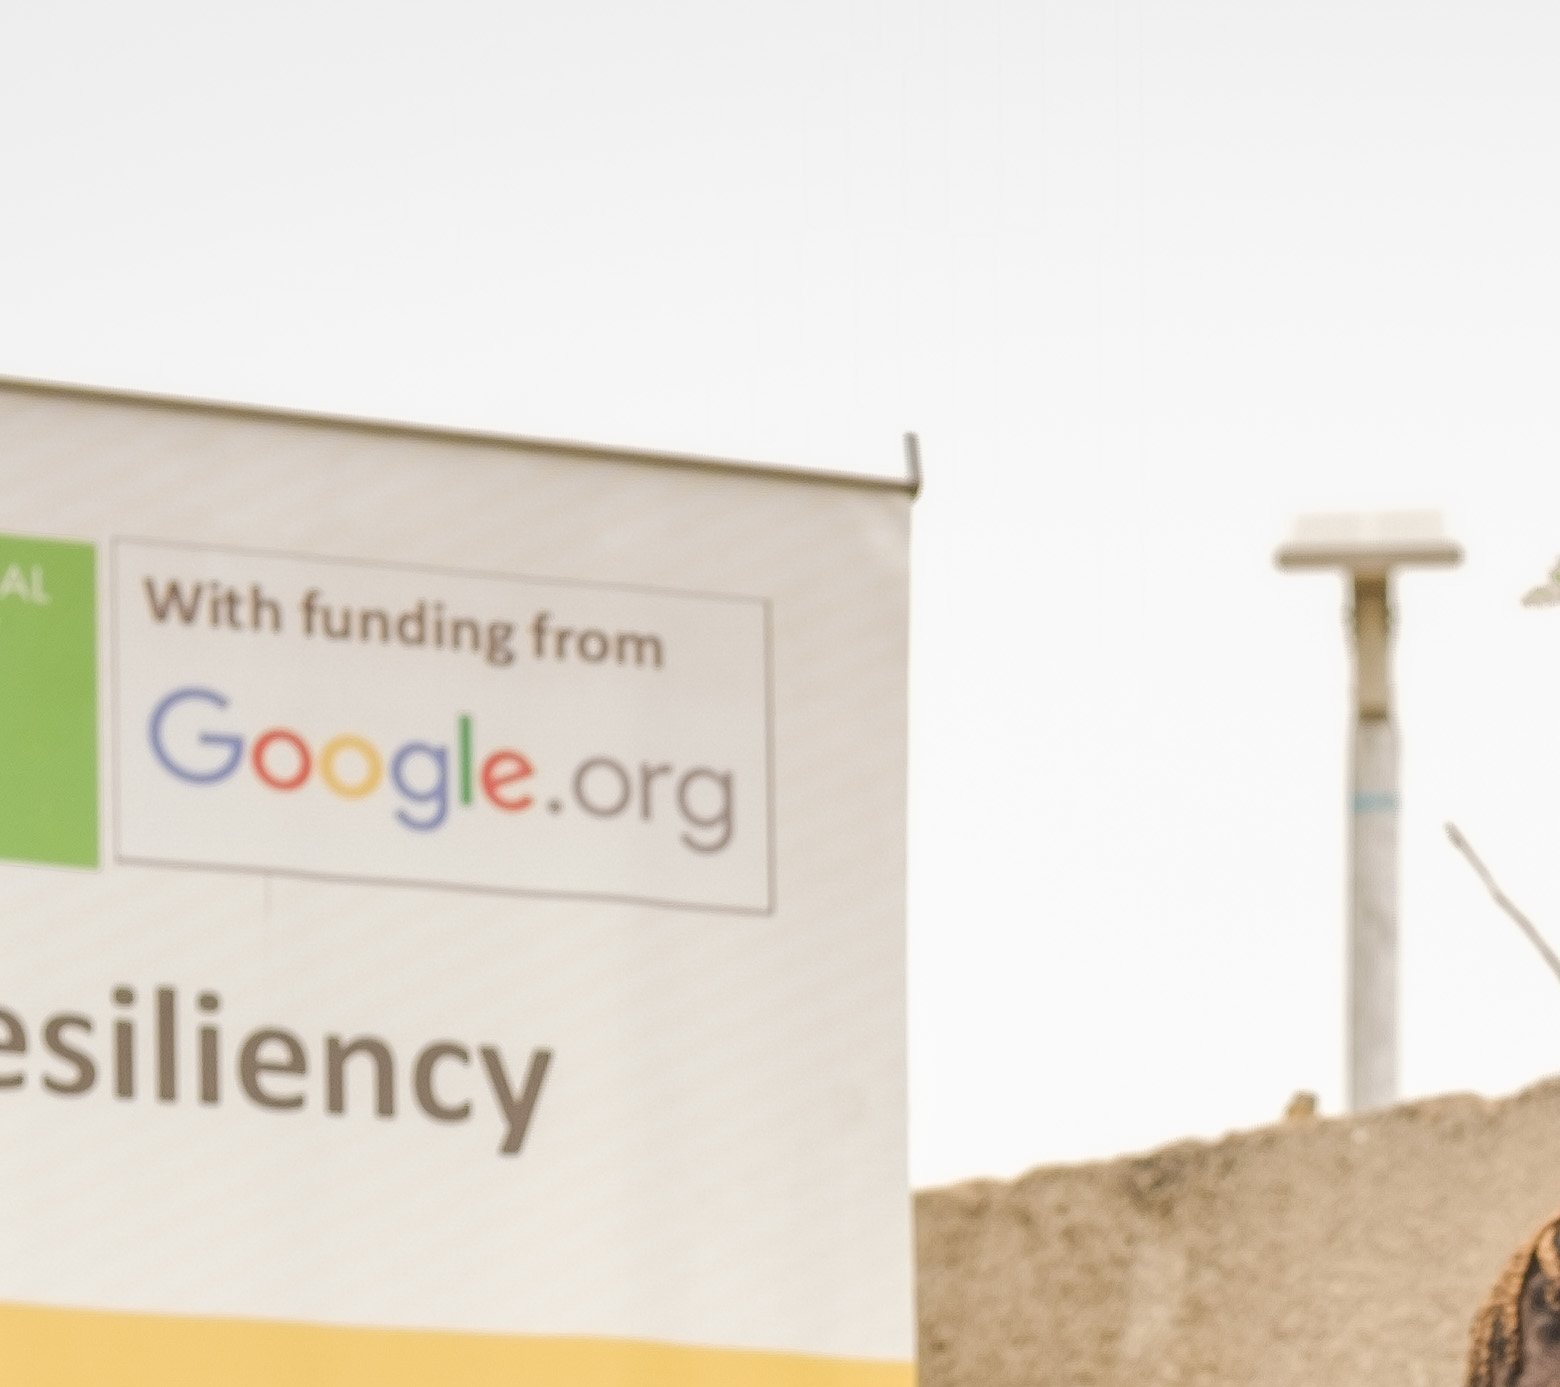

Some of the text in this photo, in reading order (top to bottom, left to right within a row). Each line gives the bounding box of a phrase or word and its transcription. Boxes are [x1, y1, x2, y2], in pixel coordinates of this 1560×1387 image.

[143, 577, 664, 669] With funding from
[147, 686, 735, 855] Google.org
